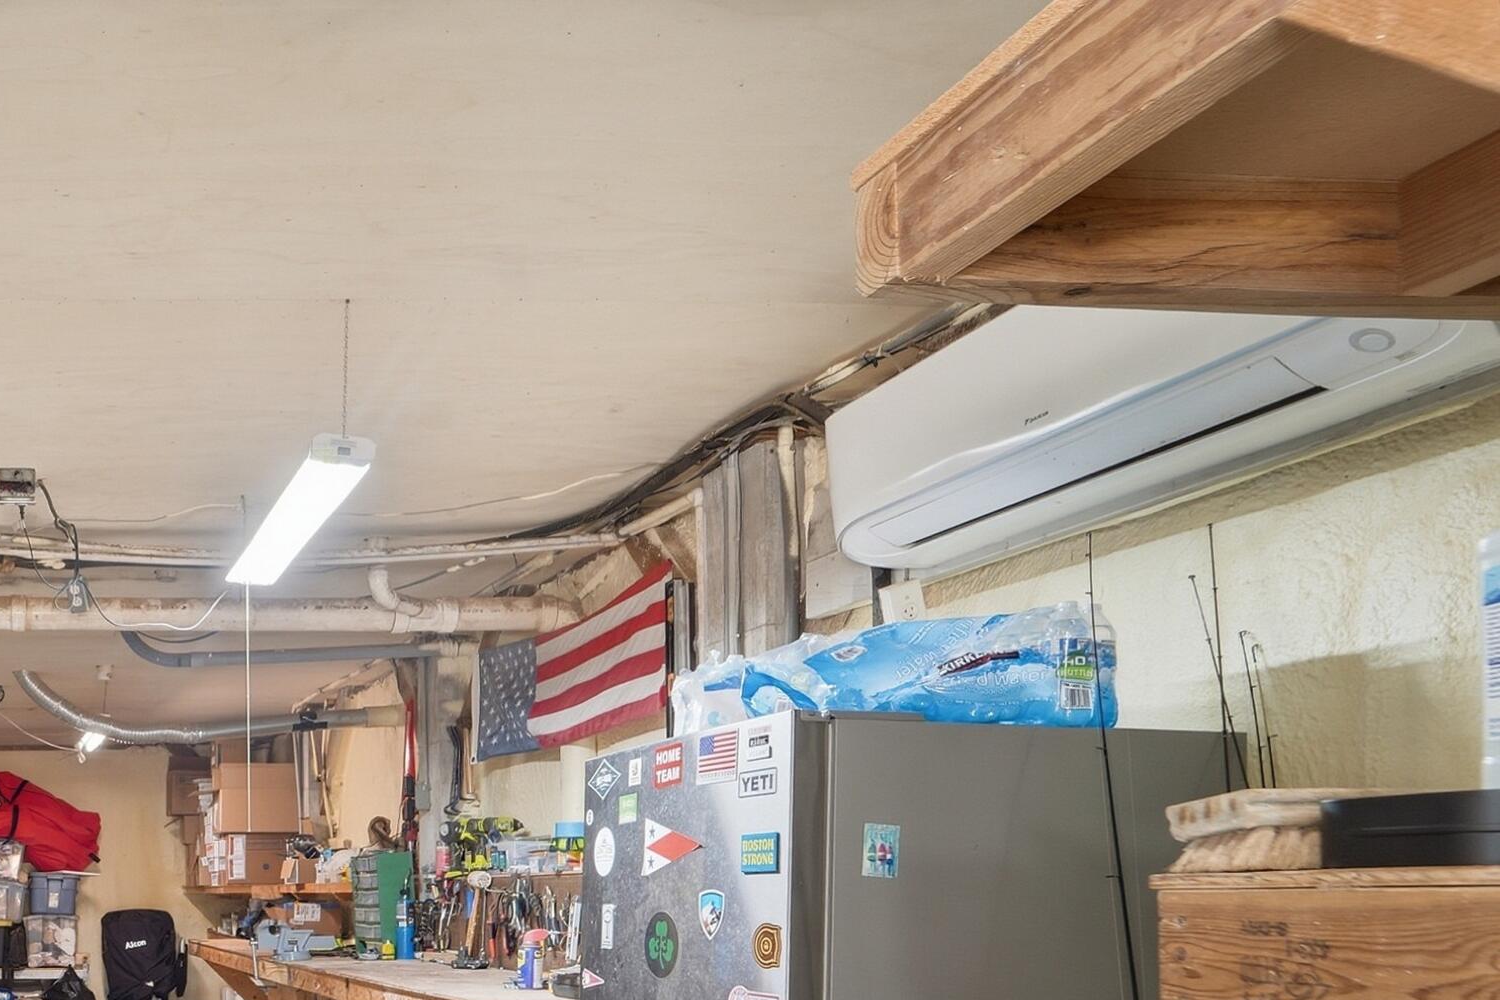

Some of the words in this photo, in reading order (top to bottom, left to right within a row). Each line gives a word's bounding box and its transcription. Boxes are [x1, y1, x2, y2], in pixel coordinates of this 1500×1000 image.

[655, 747, 682, 765] HOME
[655, 766, 681, 784] TEAM
[741, 774, 773, 792] YETI
[742, 838, 775, 851] BOSTON
[742, 851, 774, 865] STRONG
[125, 940, 147, 950] Alcon
